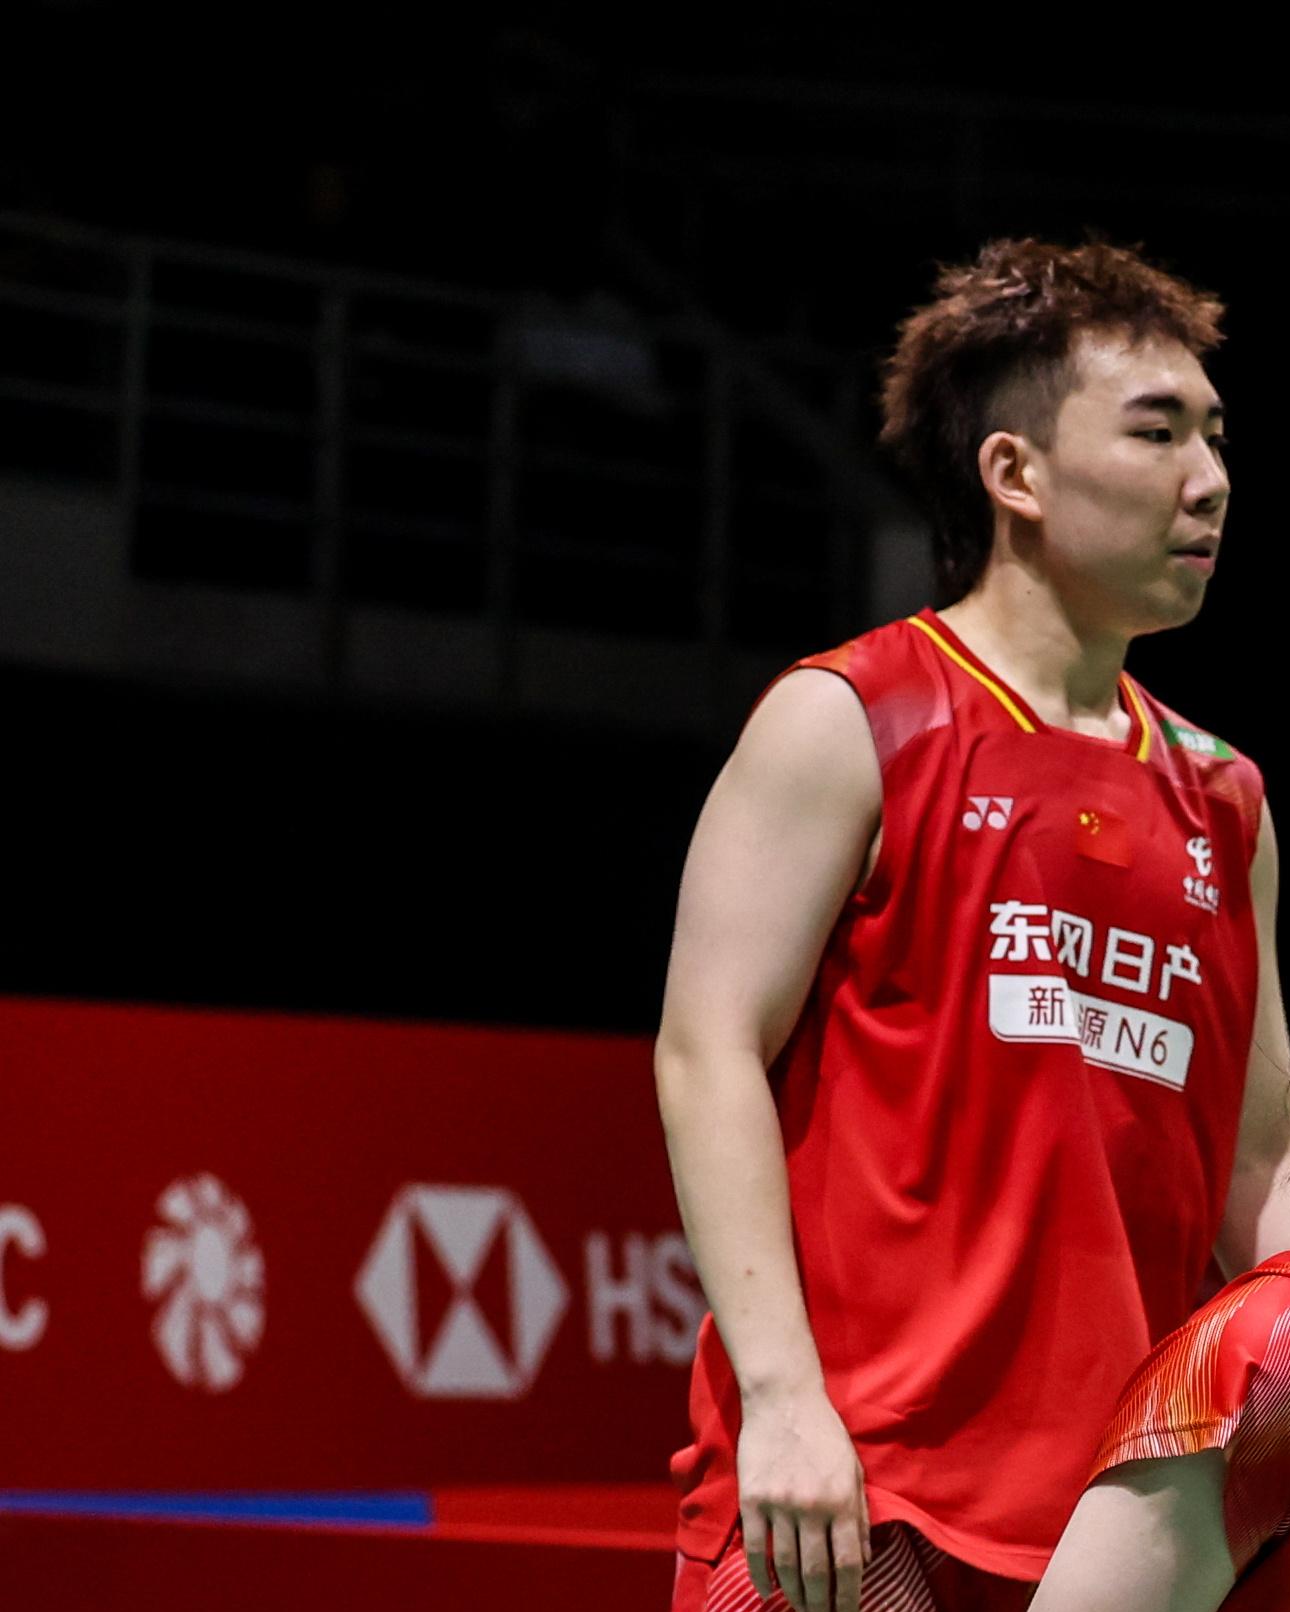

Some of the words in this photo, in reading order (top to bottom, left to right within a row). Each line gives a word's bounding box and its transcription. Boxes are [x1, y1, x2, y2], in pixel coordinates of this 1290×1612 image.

[989, 901, 1202, 1000] 东风日产
[1028, 986, 1168, 1065] 新源N6
